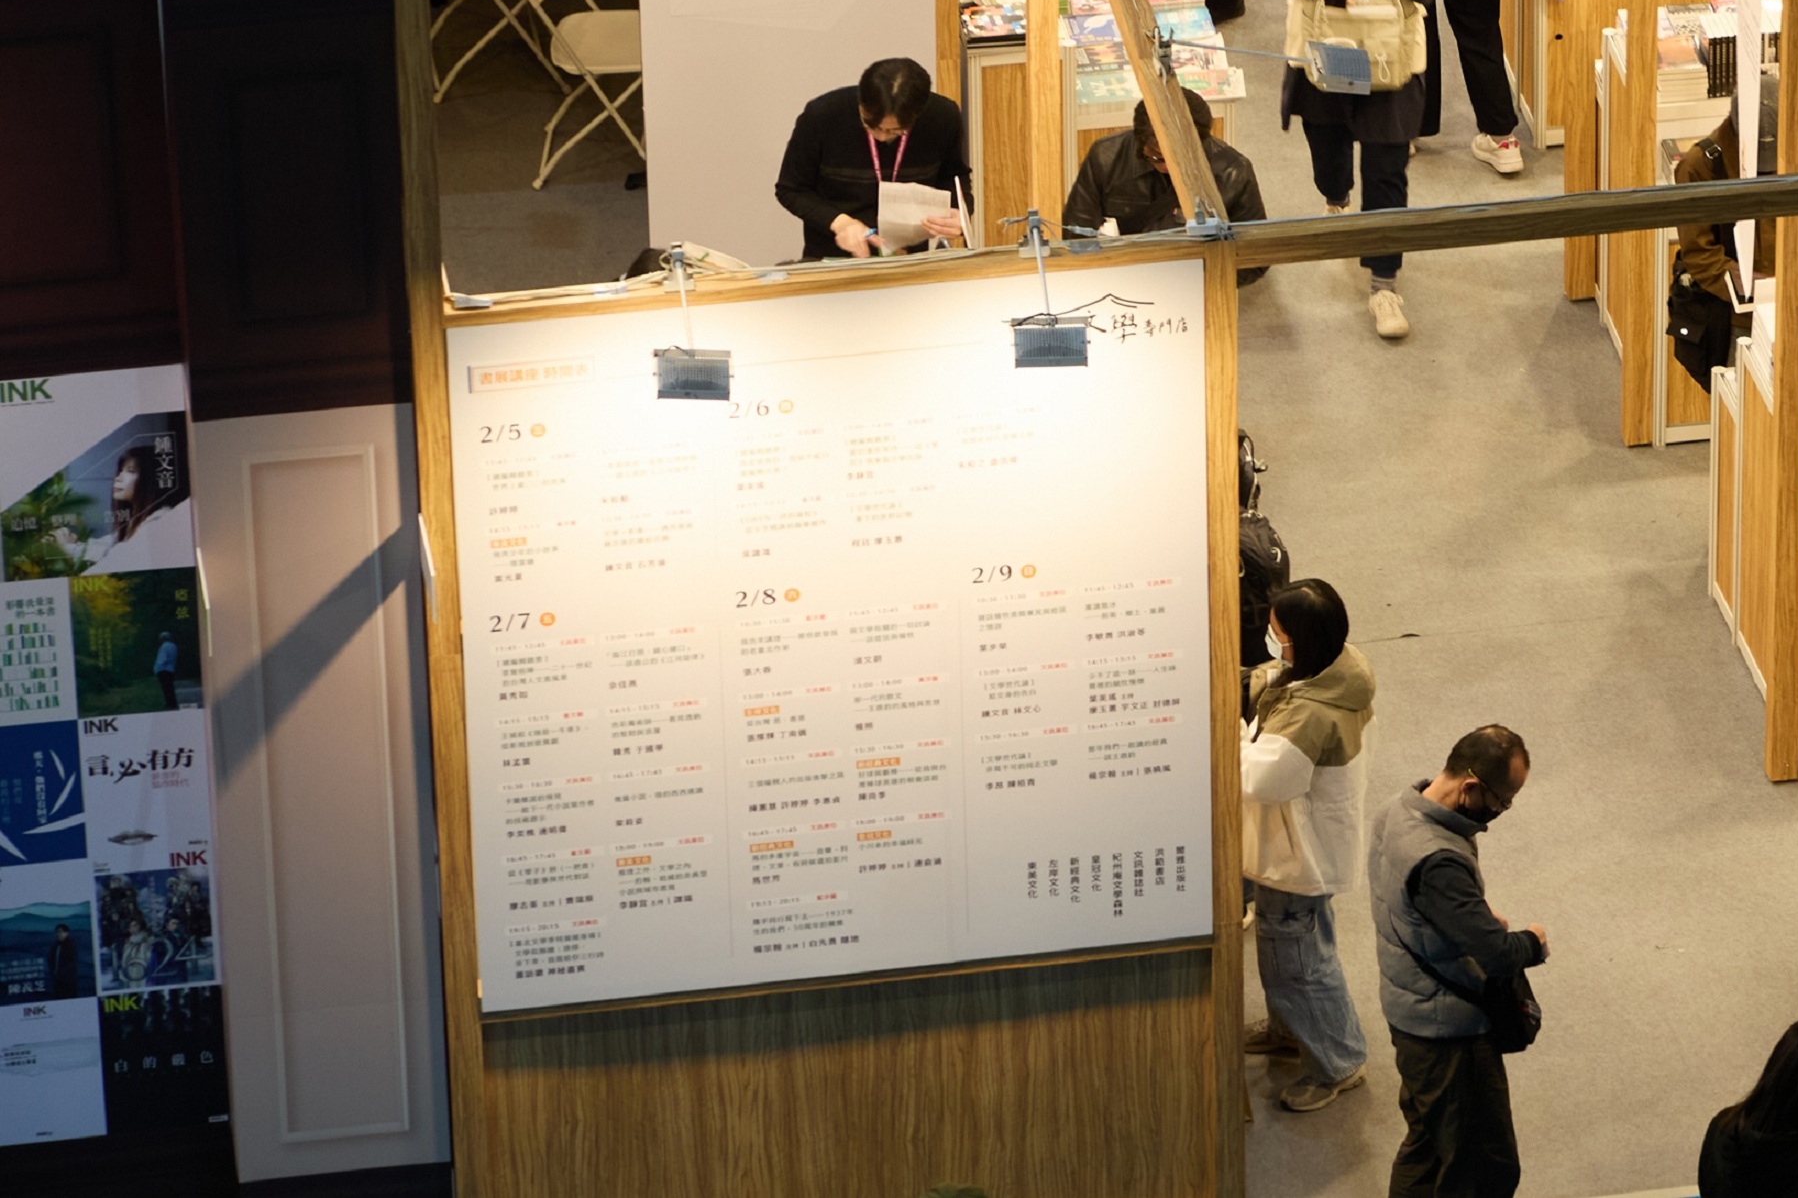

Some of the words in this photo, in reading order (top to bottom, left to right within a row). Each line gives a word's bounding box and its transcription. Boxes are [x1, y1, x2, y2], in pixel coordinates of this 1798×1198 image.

[480, 369, 538, 384] 書展講座
[0, 379, 52, 402] INK
[728, 400, 769, 419] 2/6
[480, 423, 522, 444] 2/5
[972, 565, 1013, 583] 2/9
[73, 578, 108, 593] INK
[735, 588, 776, 608] 2/8
[489, 613, 530, 633] 2/7
[743, 666, 771, 676] 張大春
[84, 718, 119, 734] INK
[169, 850, 207, 867] INK
[1155, 848, 1165, 886] 洪範書店
[1049, 859, 1059, 897] 左岸文化
[1091, 855, 1101, 892] 皇冠文化
[1134, 851, 1144, 897] 文訊雜誌社
[1176, 846, 1185, 893] 爾雅出版社
[1027, 862, 1038, 899] 東美文化
[1070, 857, 1080, 903] 新經典文化
[1112, 853, 1123, 918] 紀州庵文學森林
[23, 1006, 46, 1018] INK
[104, 996, 139, 1013] INK
